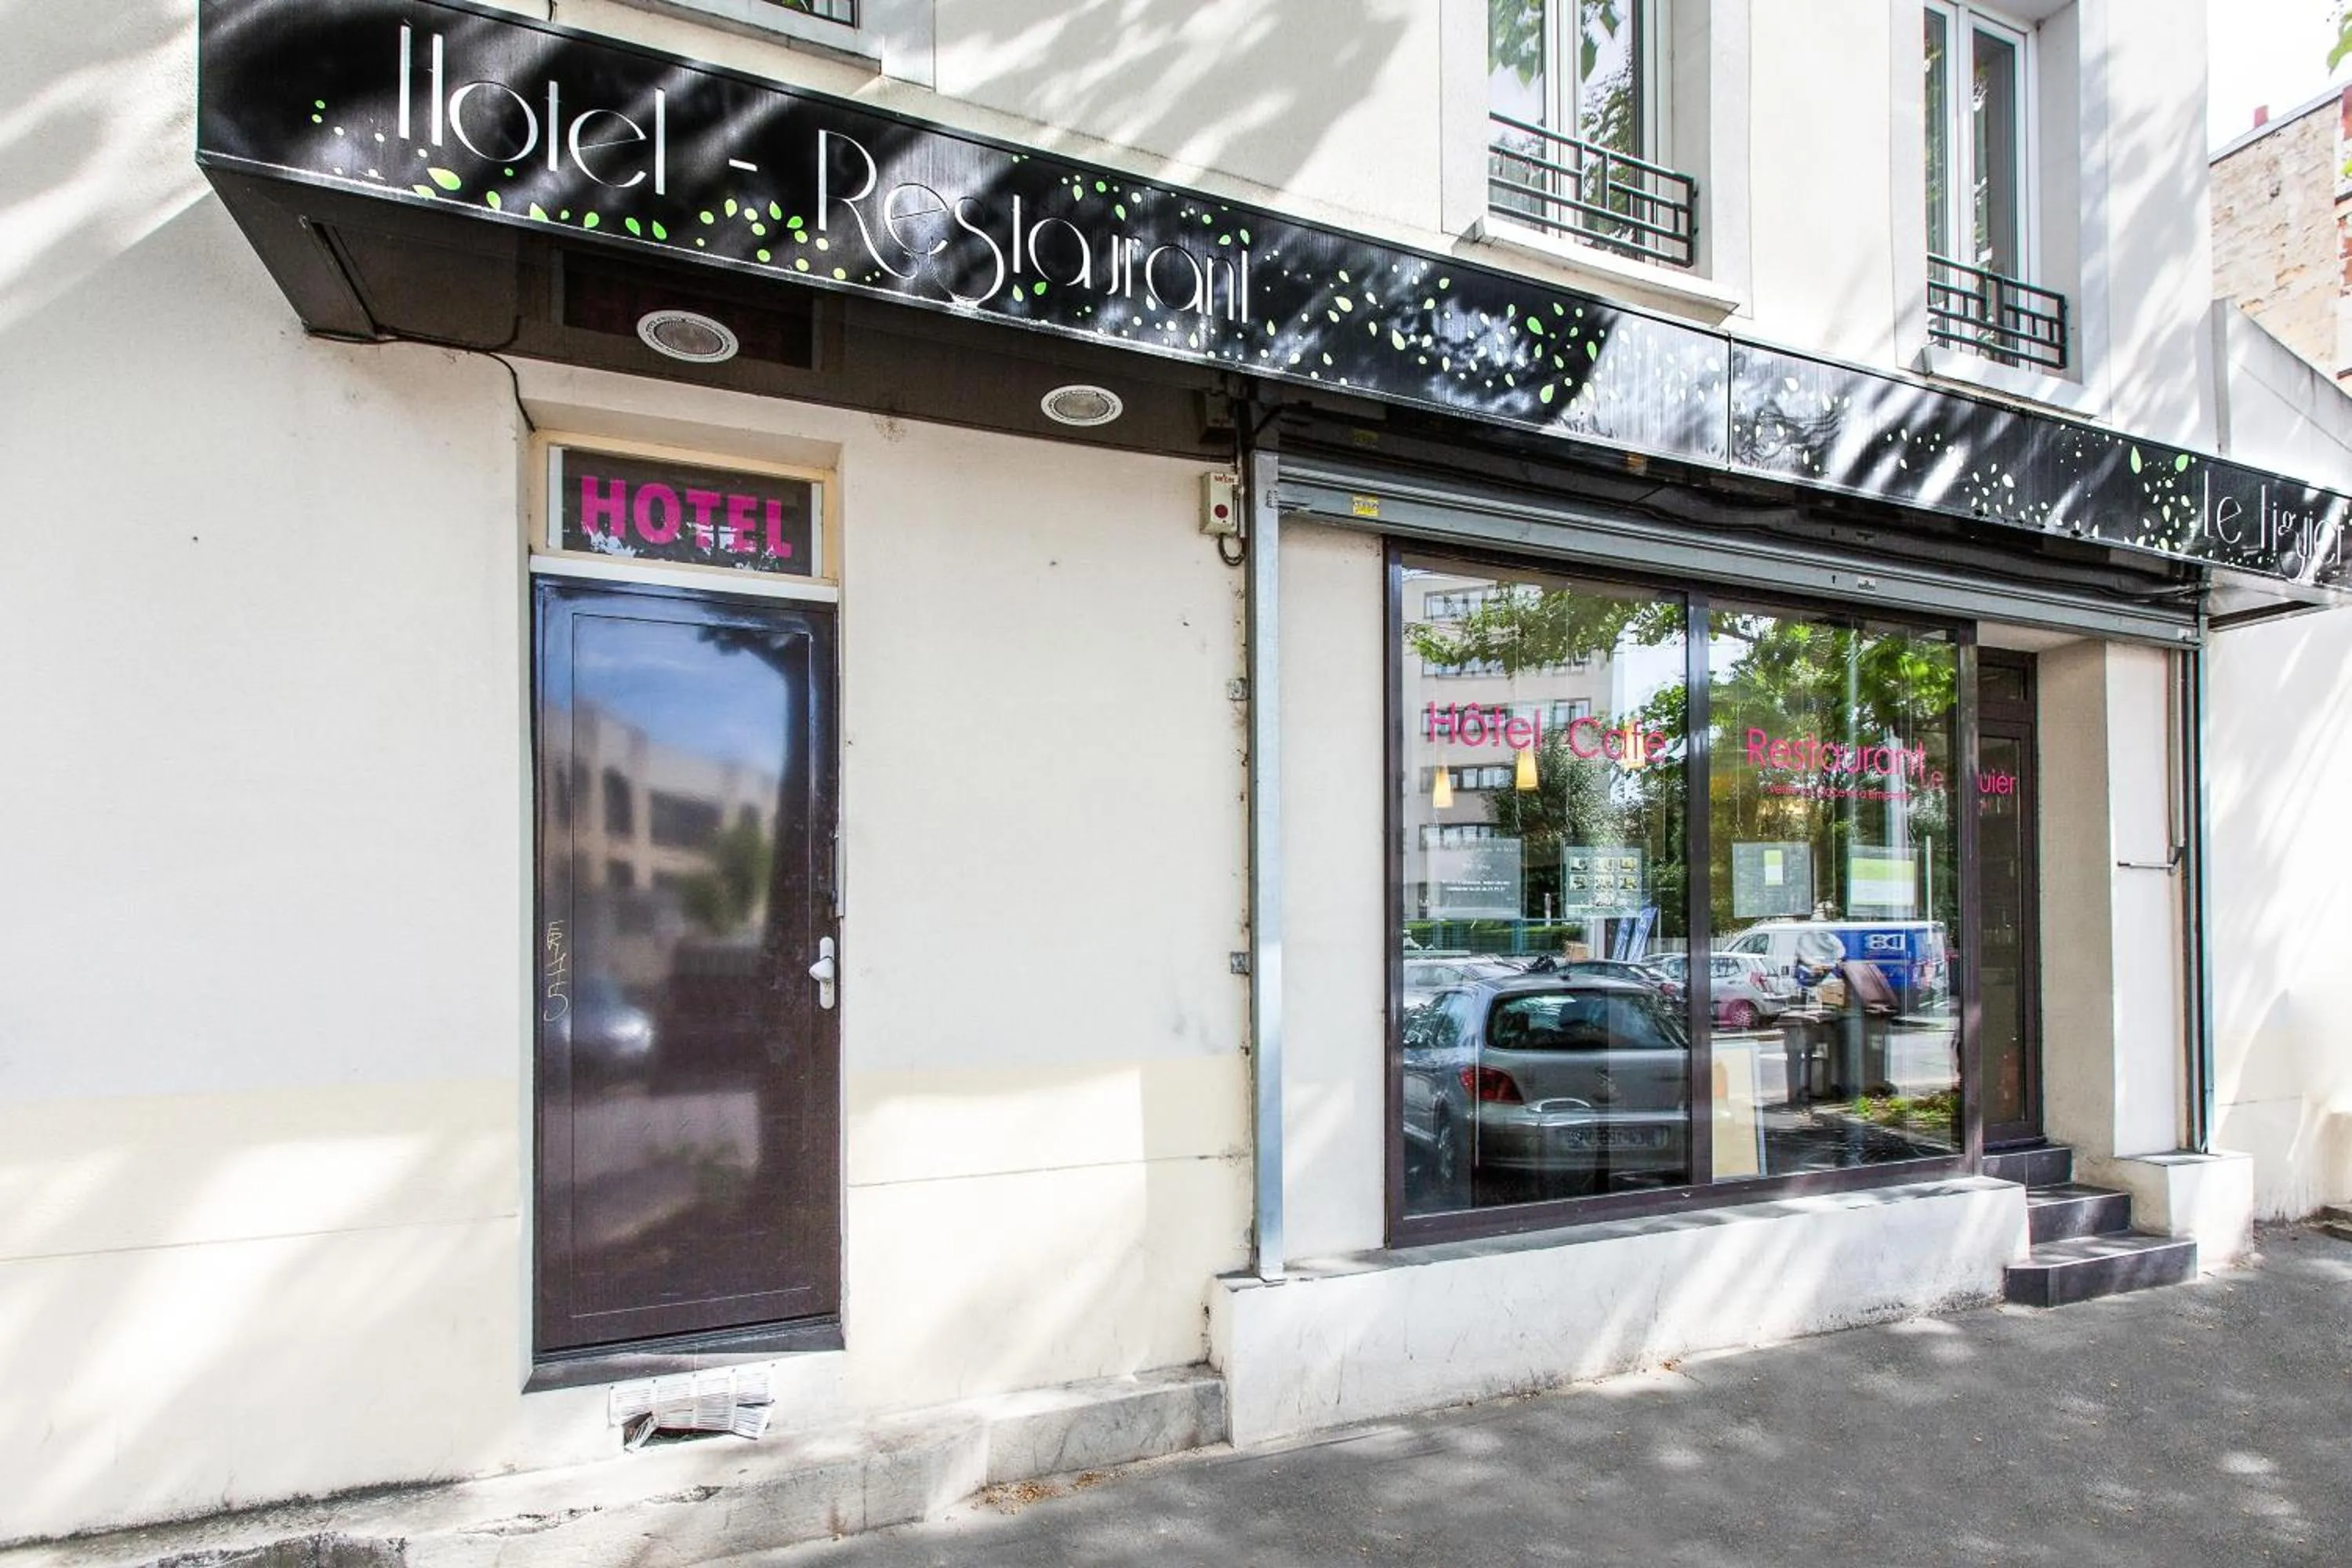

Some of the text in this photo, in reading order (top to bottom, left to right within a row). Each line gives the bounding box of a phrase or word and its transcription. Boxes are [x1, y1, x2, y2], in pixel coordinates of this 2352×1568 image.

[580, 475, 793, 559] HOTEL
[1427, 701, 1542, 753] Hôtel
[1745, 726, 1927, 780] Restaurant
